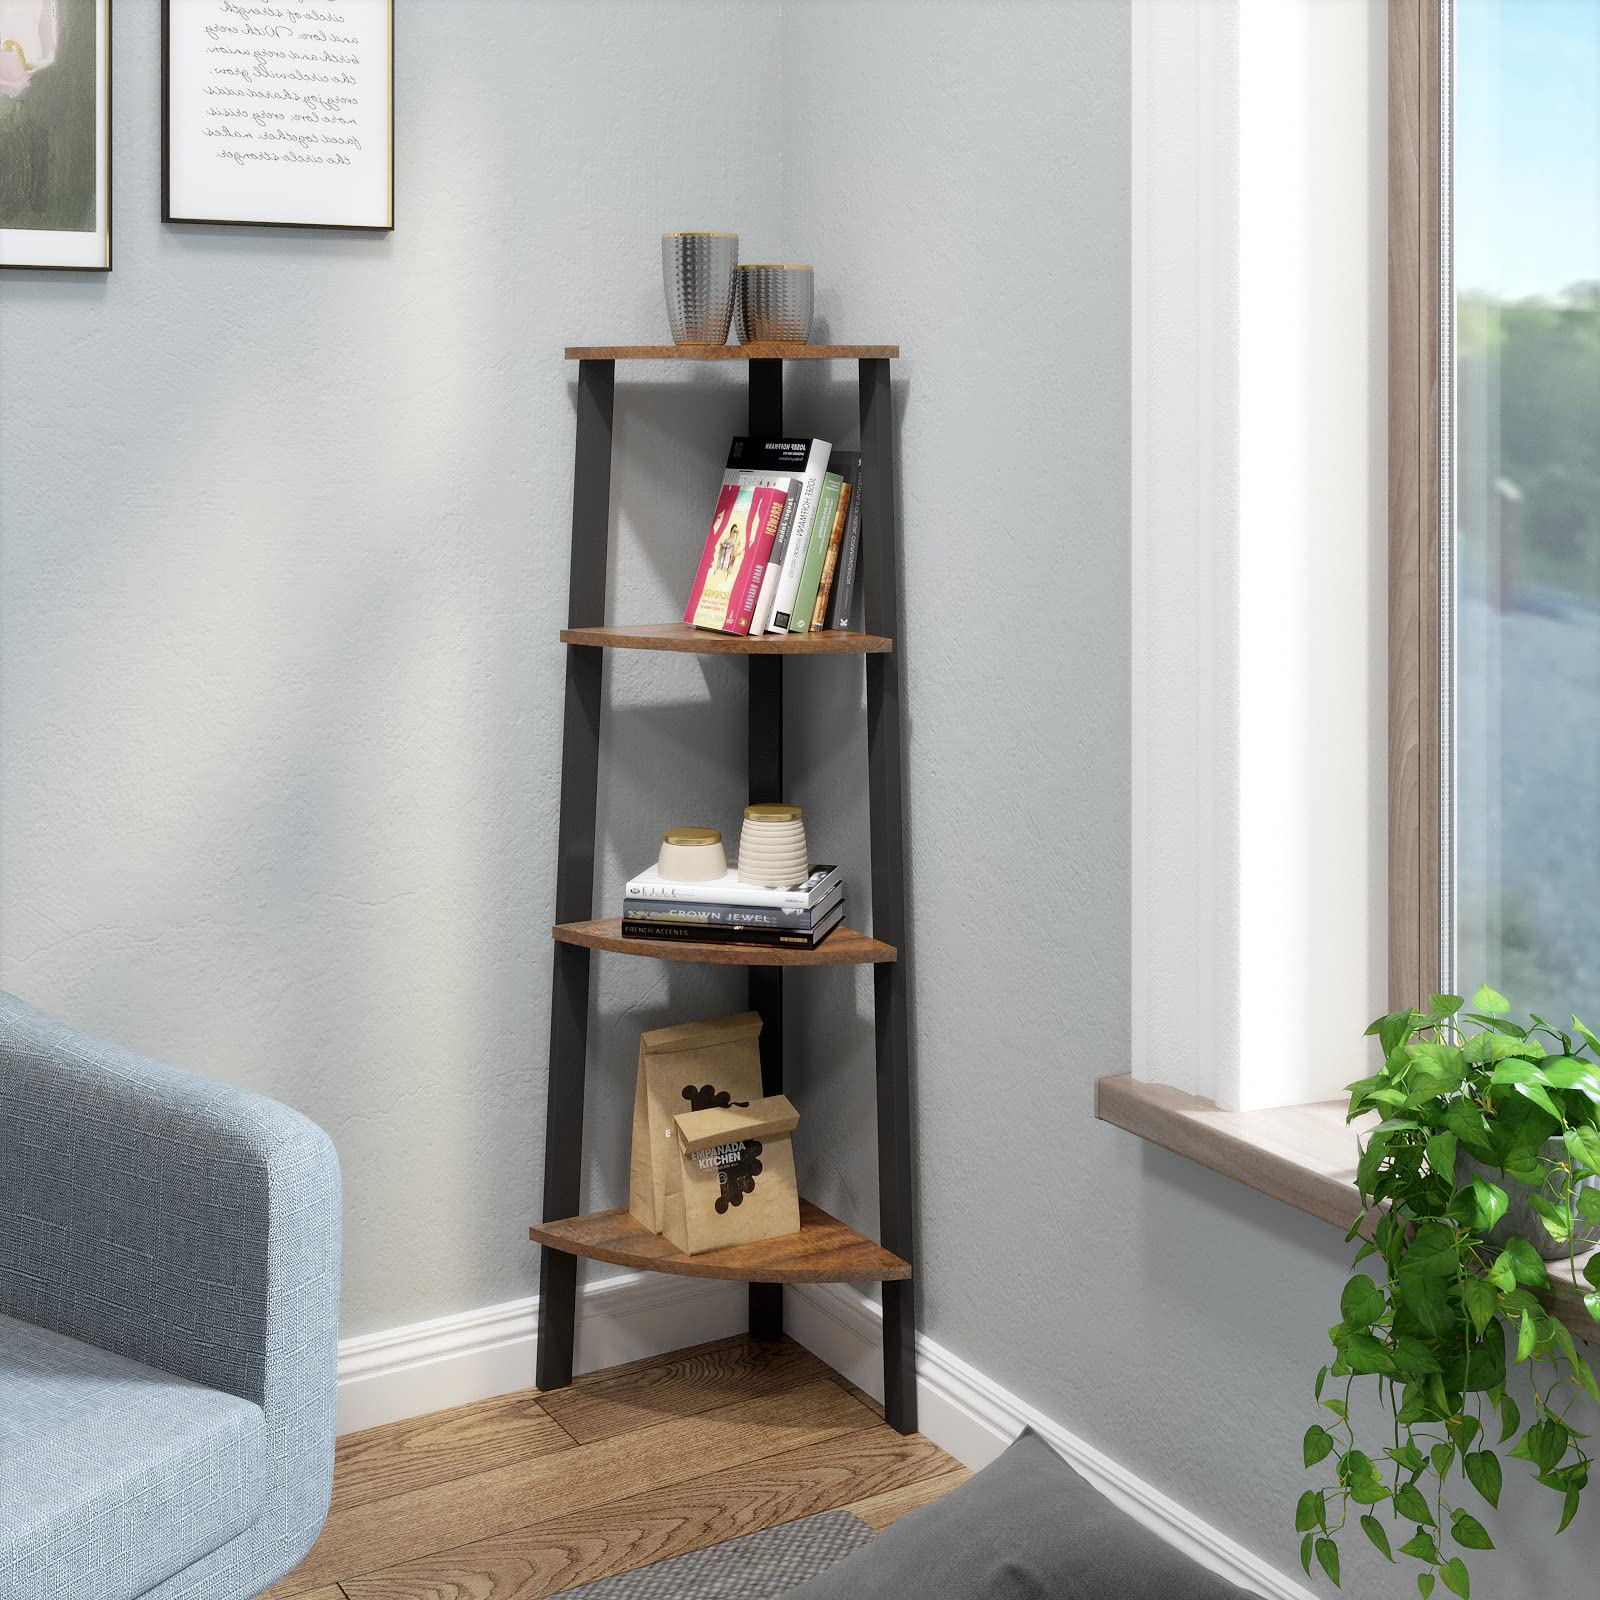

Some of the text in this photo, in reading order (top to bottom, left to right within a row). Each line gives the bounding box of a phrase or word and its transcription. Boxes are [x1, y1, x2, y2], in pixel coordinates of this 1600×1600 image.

[669, 910, 720, 919] CROWN
[726, 913, 771, 922] JEWEL
[656, 928, 688, 936] ACCENTS
[691, 1141, 746, 1160] EMPANADA
[699, 1152, 741, 1169] KITCHEN
